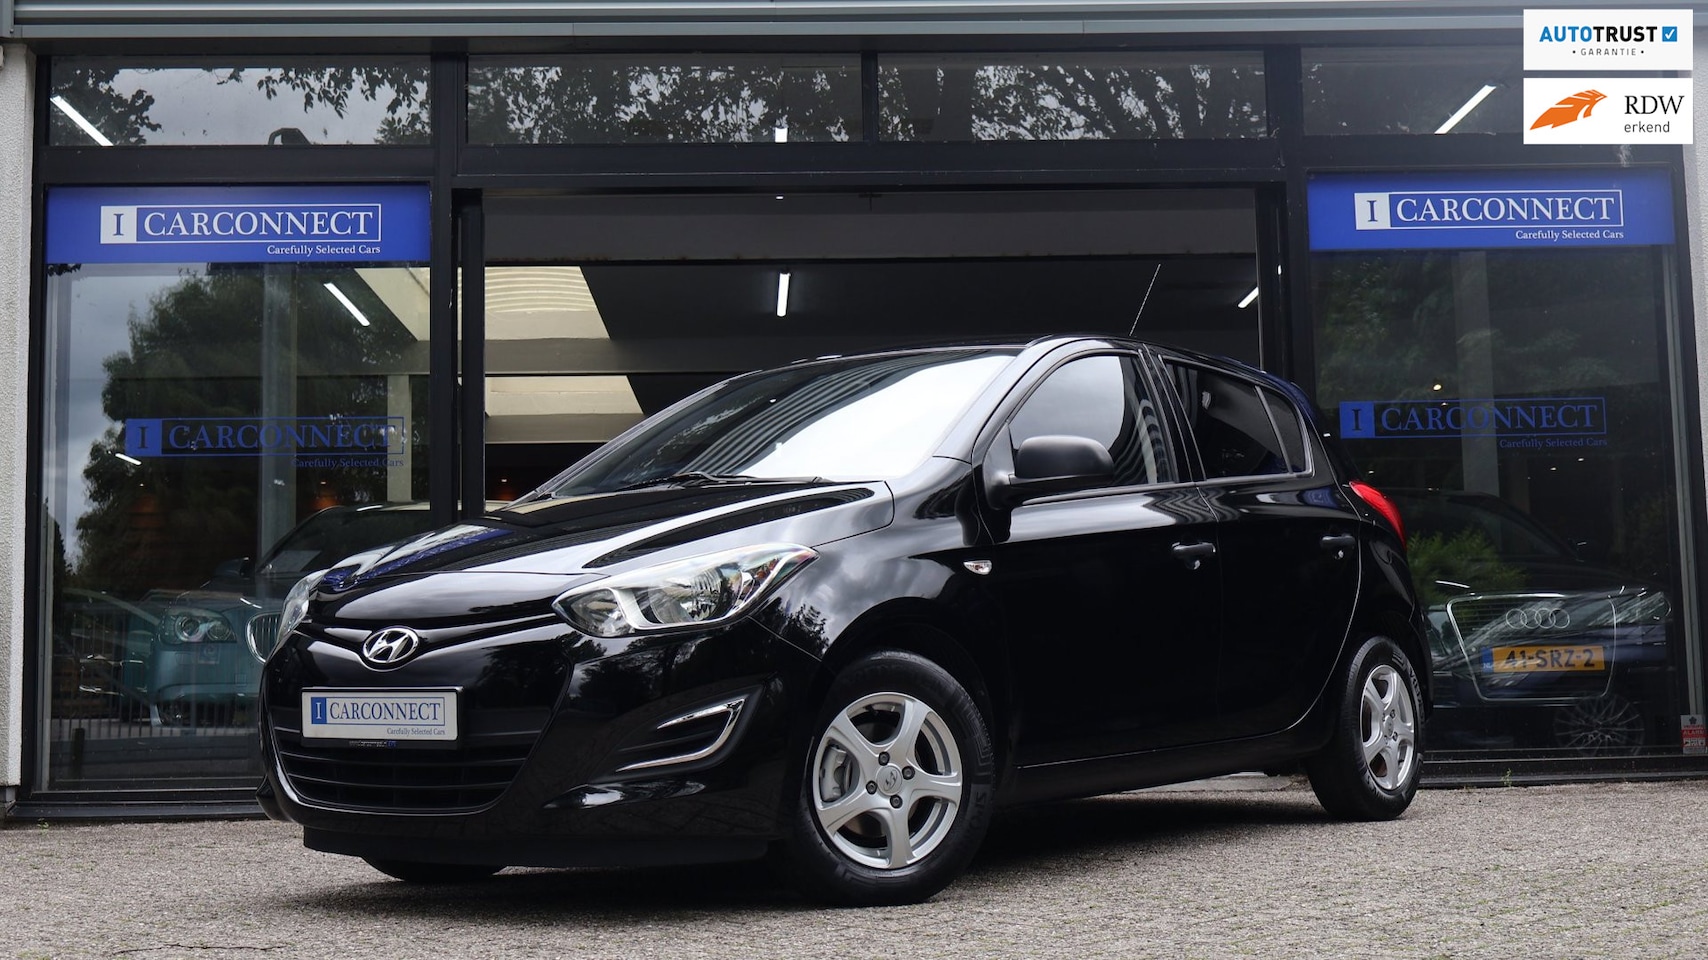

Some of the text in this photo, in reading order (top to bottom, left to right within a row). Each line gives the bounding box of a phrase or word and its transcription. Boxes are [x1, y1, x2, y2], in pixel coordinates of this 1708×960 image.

[1396, 196, 1615, 222] CARCONNECT
[143, 211, 374, 236] CARCONNECT
[1515, 229, 1624, 242] Carefully Selected Cars
[267, 244, 381, 257] Carefully Selected Cars
[1381, 404, 1598, 431] CARCONNECT
[169, 425, 396, 449] CARCONNECT
[1499, 437, 1608, 450] Carefully Selected Cars
[293, 457, 404, 469] Carefully Selected Cars
[1504, 648, 1596, 669] 41-SRZ-2
[330, 702, 441, 721] CARCONNECT
[387, 727, 445, 738] Carefully Selected Cars
